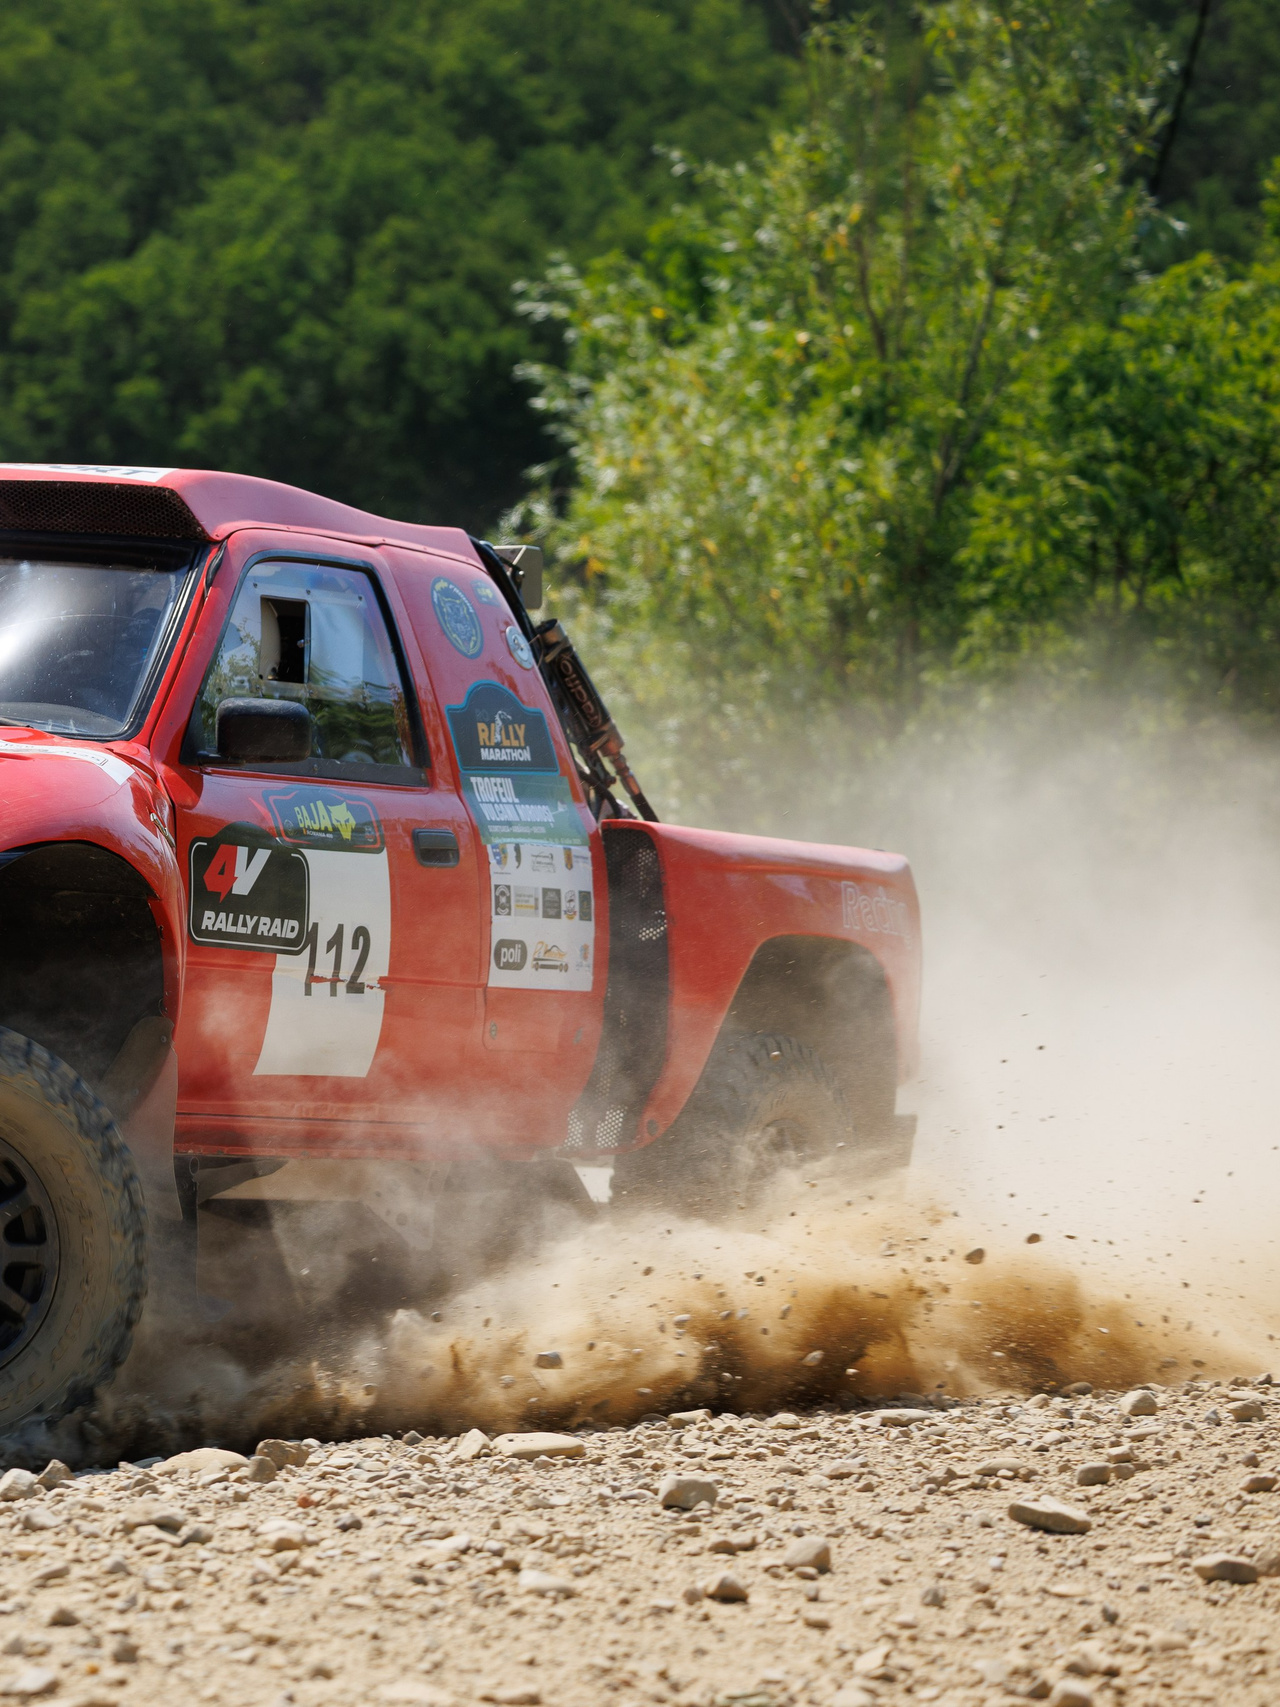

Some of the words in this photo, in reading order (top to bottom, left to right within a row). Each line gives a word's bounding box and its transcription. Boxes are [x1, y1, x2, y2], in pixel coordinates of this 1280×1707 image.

[477, 722, 526, 747] RALLY
[481, 746, 531, 761] MARATHON
[470, 777, 520, 803] TROFEUL
[294, 800, 333, 831] BAJA
[203, 844, 272, 903] 4V
[201, 911, 258, 935] RALLY
[257, 916, 300, 939] RAID
[304, 922, 371, 997] 112
[500, 943, 522, 967] poli
